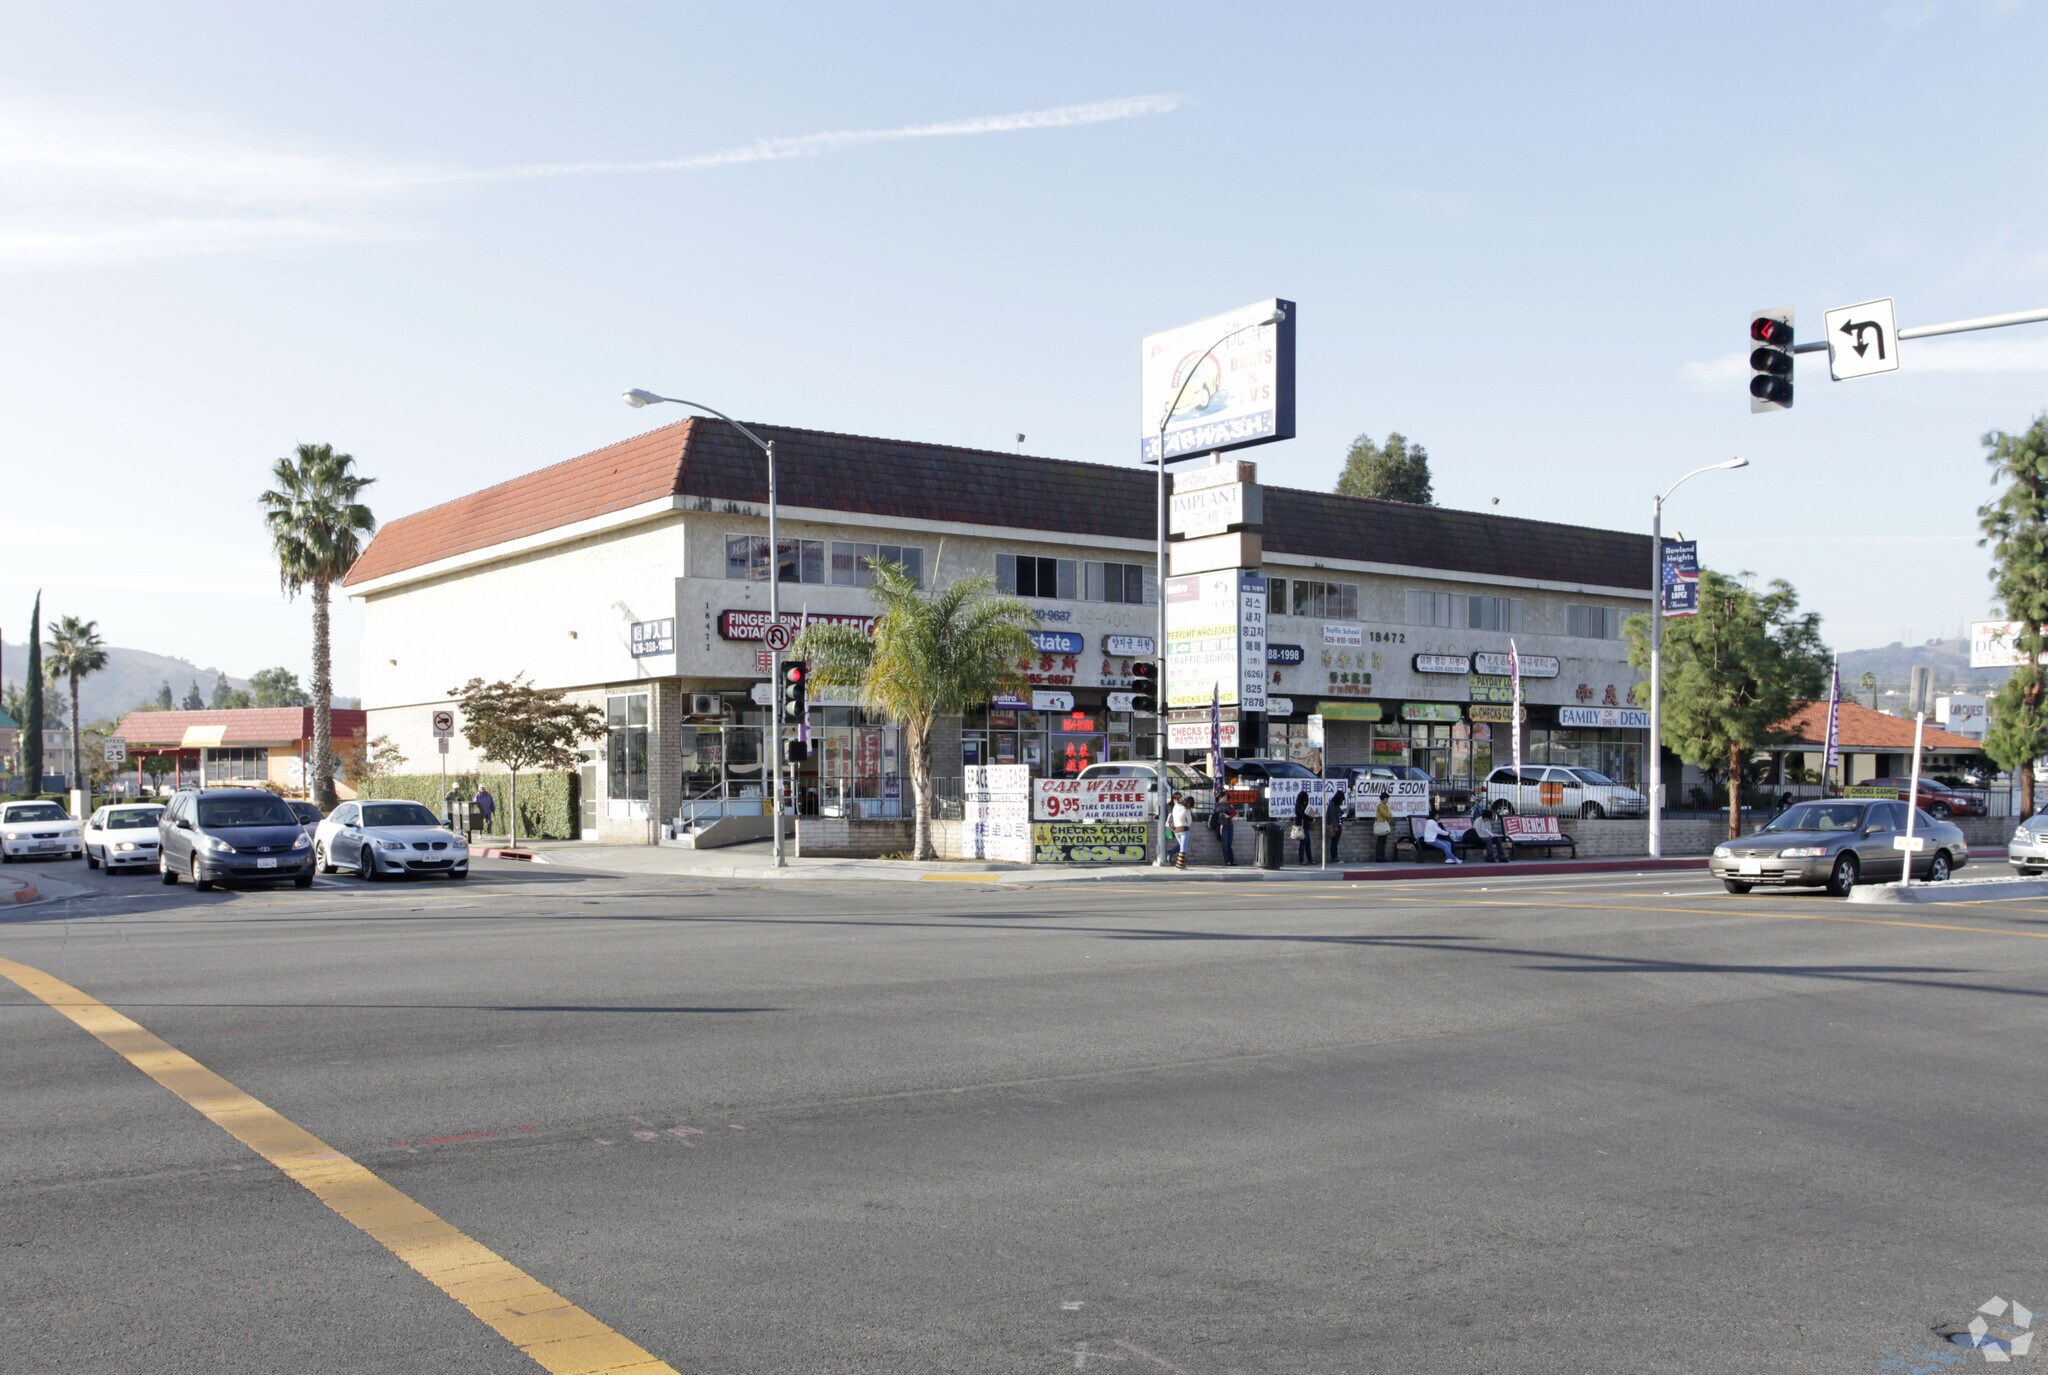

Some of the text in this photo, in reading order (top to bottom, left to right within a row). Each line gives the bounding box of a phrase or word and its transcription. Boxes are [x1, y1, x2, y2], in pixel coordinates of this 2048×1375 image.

[1174, 487, 1238, 513] IMPLANT
[1666, 545, 1694, 554] Rowland
[1168, 630, 1195, 640] PERFUME
[1369, 632, 1405, 643] 18472
[1170, 653, 1236, 665] TRAFFIC SCHOOL
[1244, 670, 1263, 679] (626)
[1477, 677, 1526, 687] PAYDAY LOS
[1245, 685, 1262, 693] 825
[1172, 694, 1233, 704] CHECKS CAHED
[1243, 698, 1264, 707] 7878
[1479, 707, 1501, 718] CHECKS
[1562, 710, 1650, 725] FAMILY DENT
[1171, 725, 1236, 737] CHECKS CAHED
[107, 751, 123, 760] 25
[968, 768, 987, 788] SPACE
[1042, 780, 1139, 793] CAR WASH
[1357, 782, 1426, 794] COMING SOON
[1098, 793, 1145, 802] FREE
[1522, 817, 1558, 832] BENCH AD
[1050, 826, 1145, 834] CHECKS CASHED
[1104, 835, 1144, 843] LOANS
[1070, 845, 1145, 861] GOLD
